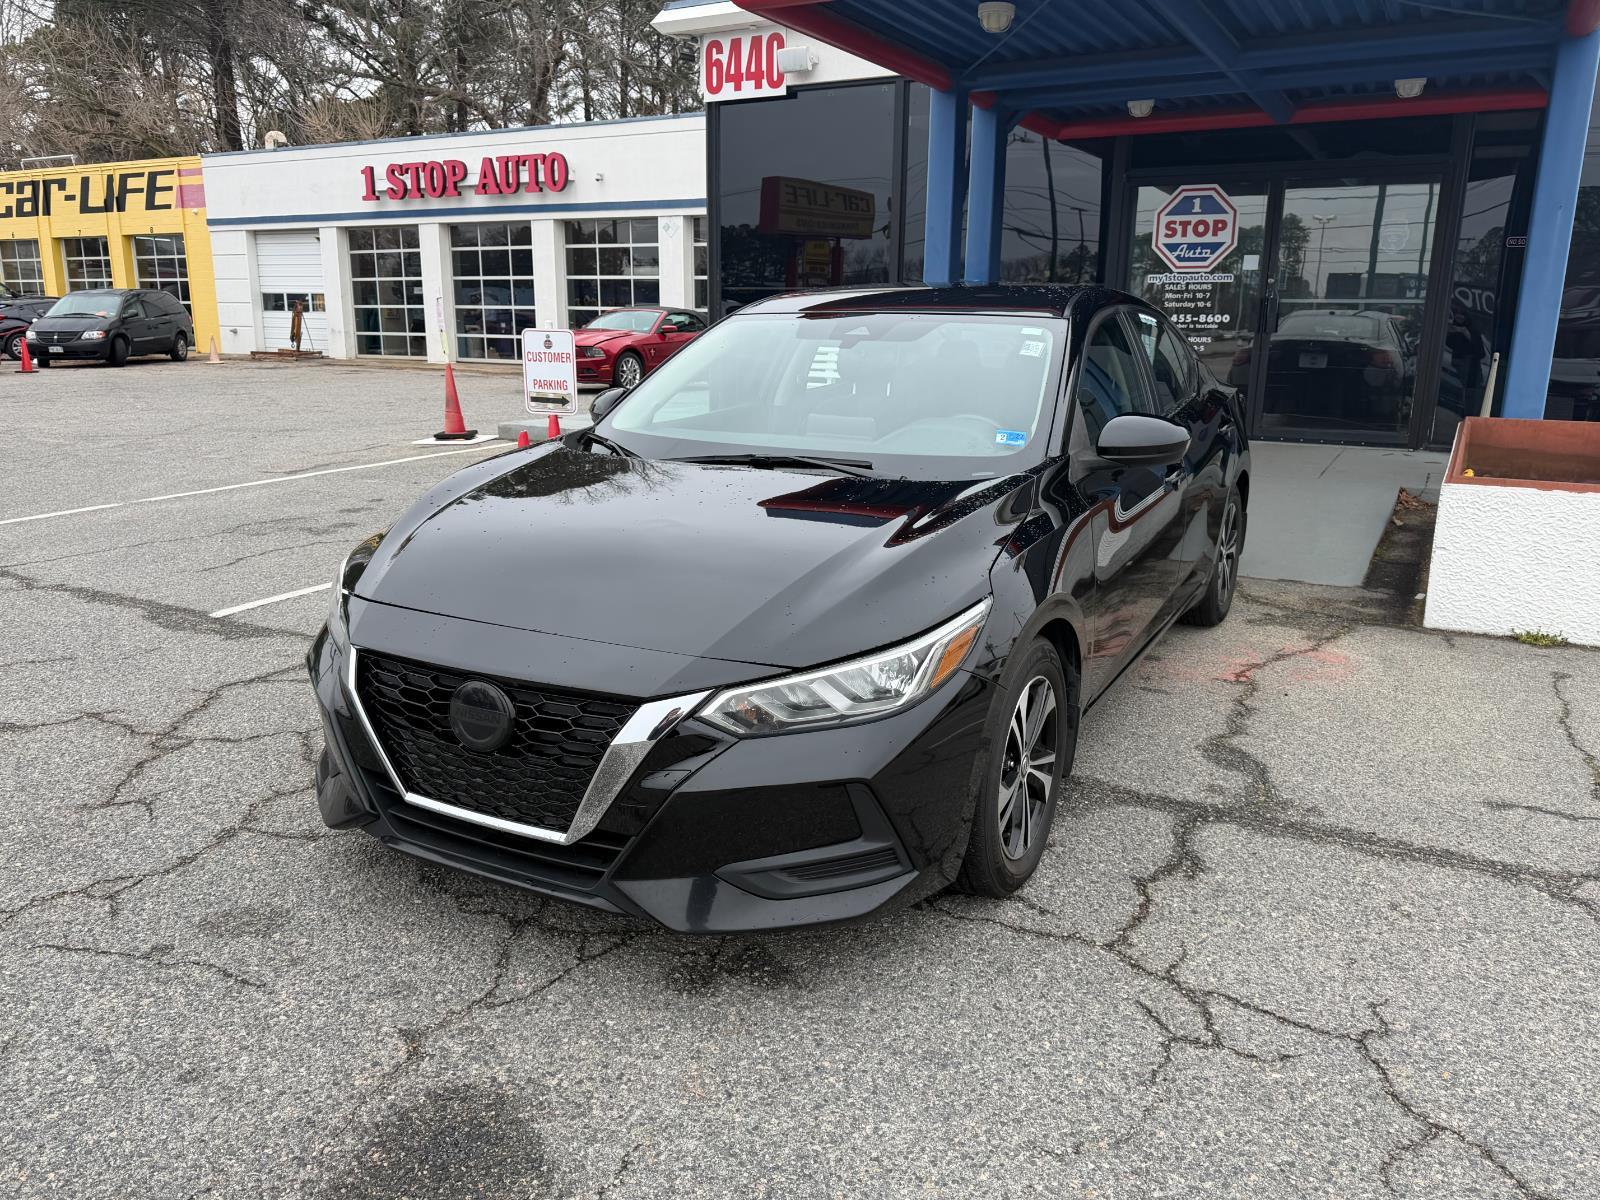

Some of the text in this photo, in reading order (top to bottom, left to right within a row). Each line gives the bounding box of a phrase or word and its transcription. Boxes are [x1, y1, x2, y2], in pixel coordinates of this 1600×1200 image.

[705, 32, 785, 95] 6440
[361, 152, 569, 201] 1 STOP AUTO
[1191, 197, 1202, 213] 1
[1163, 219, 1228, 239] STOP
[1171, 244, 1213, 258] Auto
[1148, 273, 1234, 284] my1stopauto.com
[1170, 314, 1231, 323] 455-8600
[526, 351, 571, 363] CUSTOMER
[533, 378, 568, 391] PARKING
